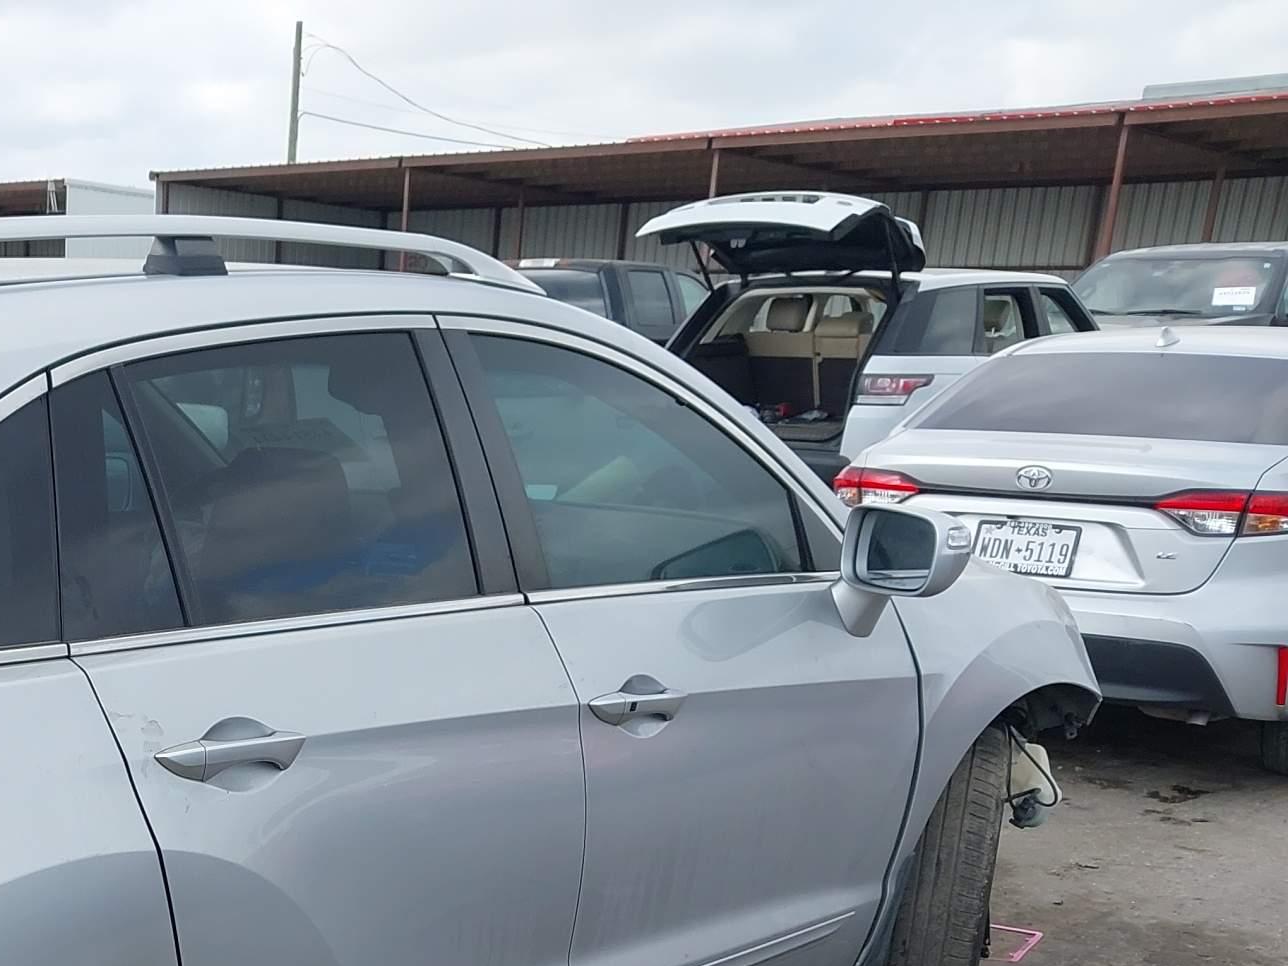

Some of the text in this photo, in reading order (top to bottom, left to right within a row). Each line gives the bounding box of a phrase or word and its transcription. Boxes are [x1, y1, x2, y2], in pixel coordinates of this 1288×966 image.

[1010, 526, 1049, 537] TEXAS
[979, 536, 1070, 565] WDN 5119
